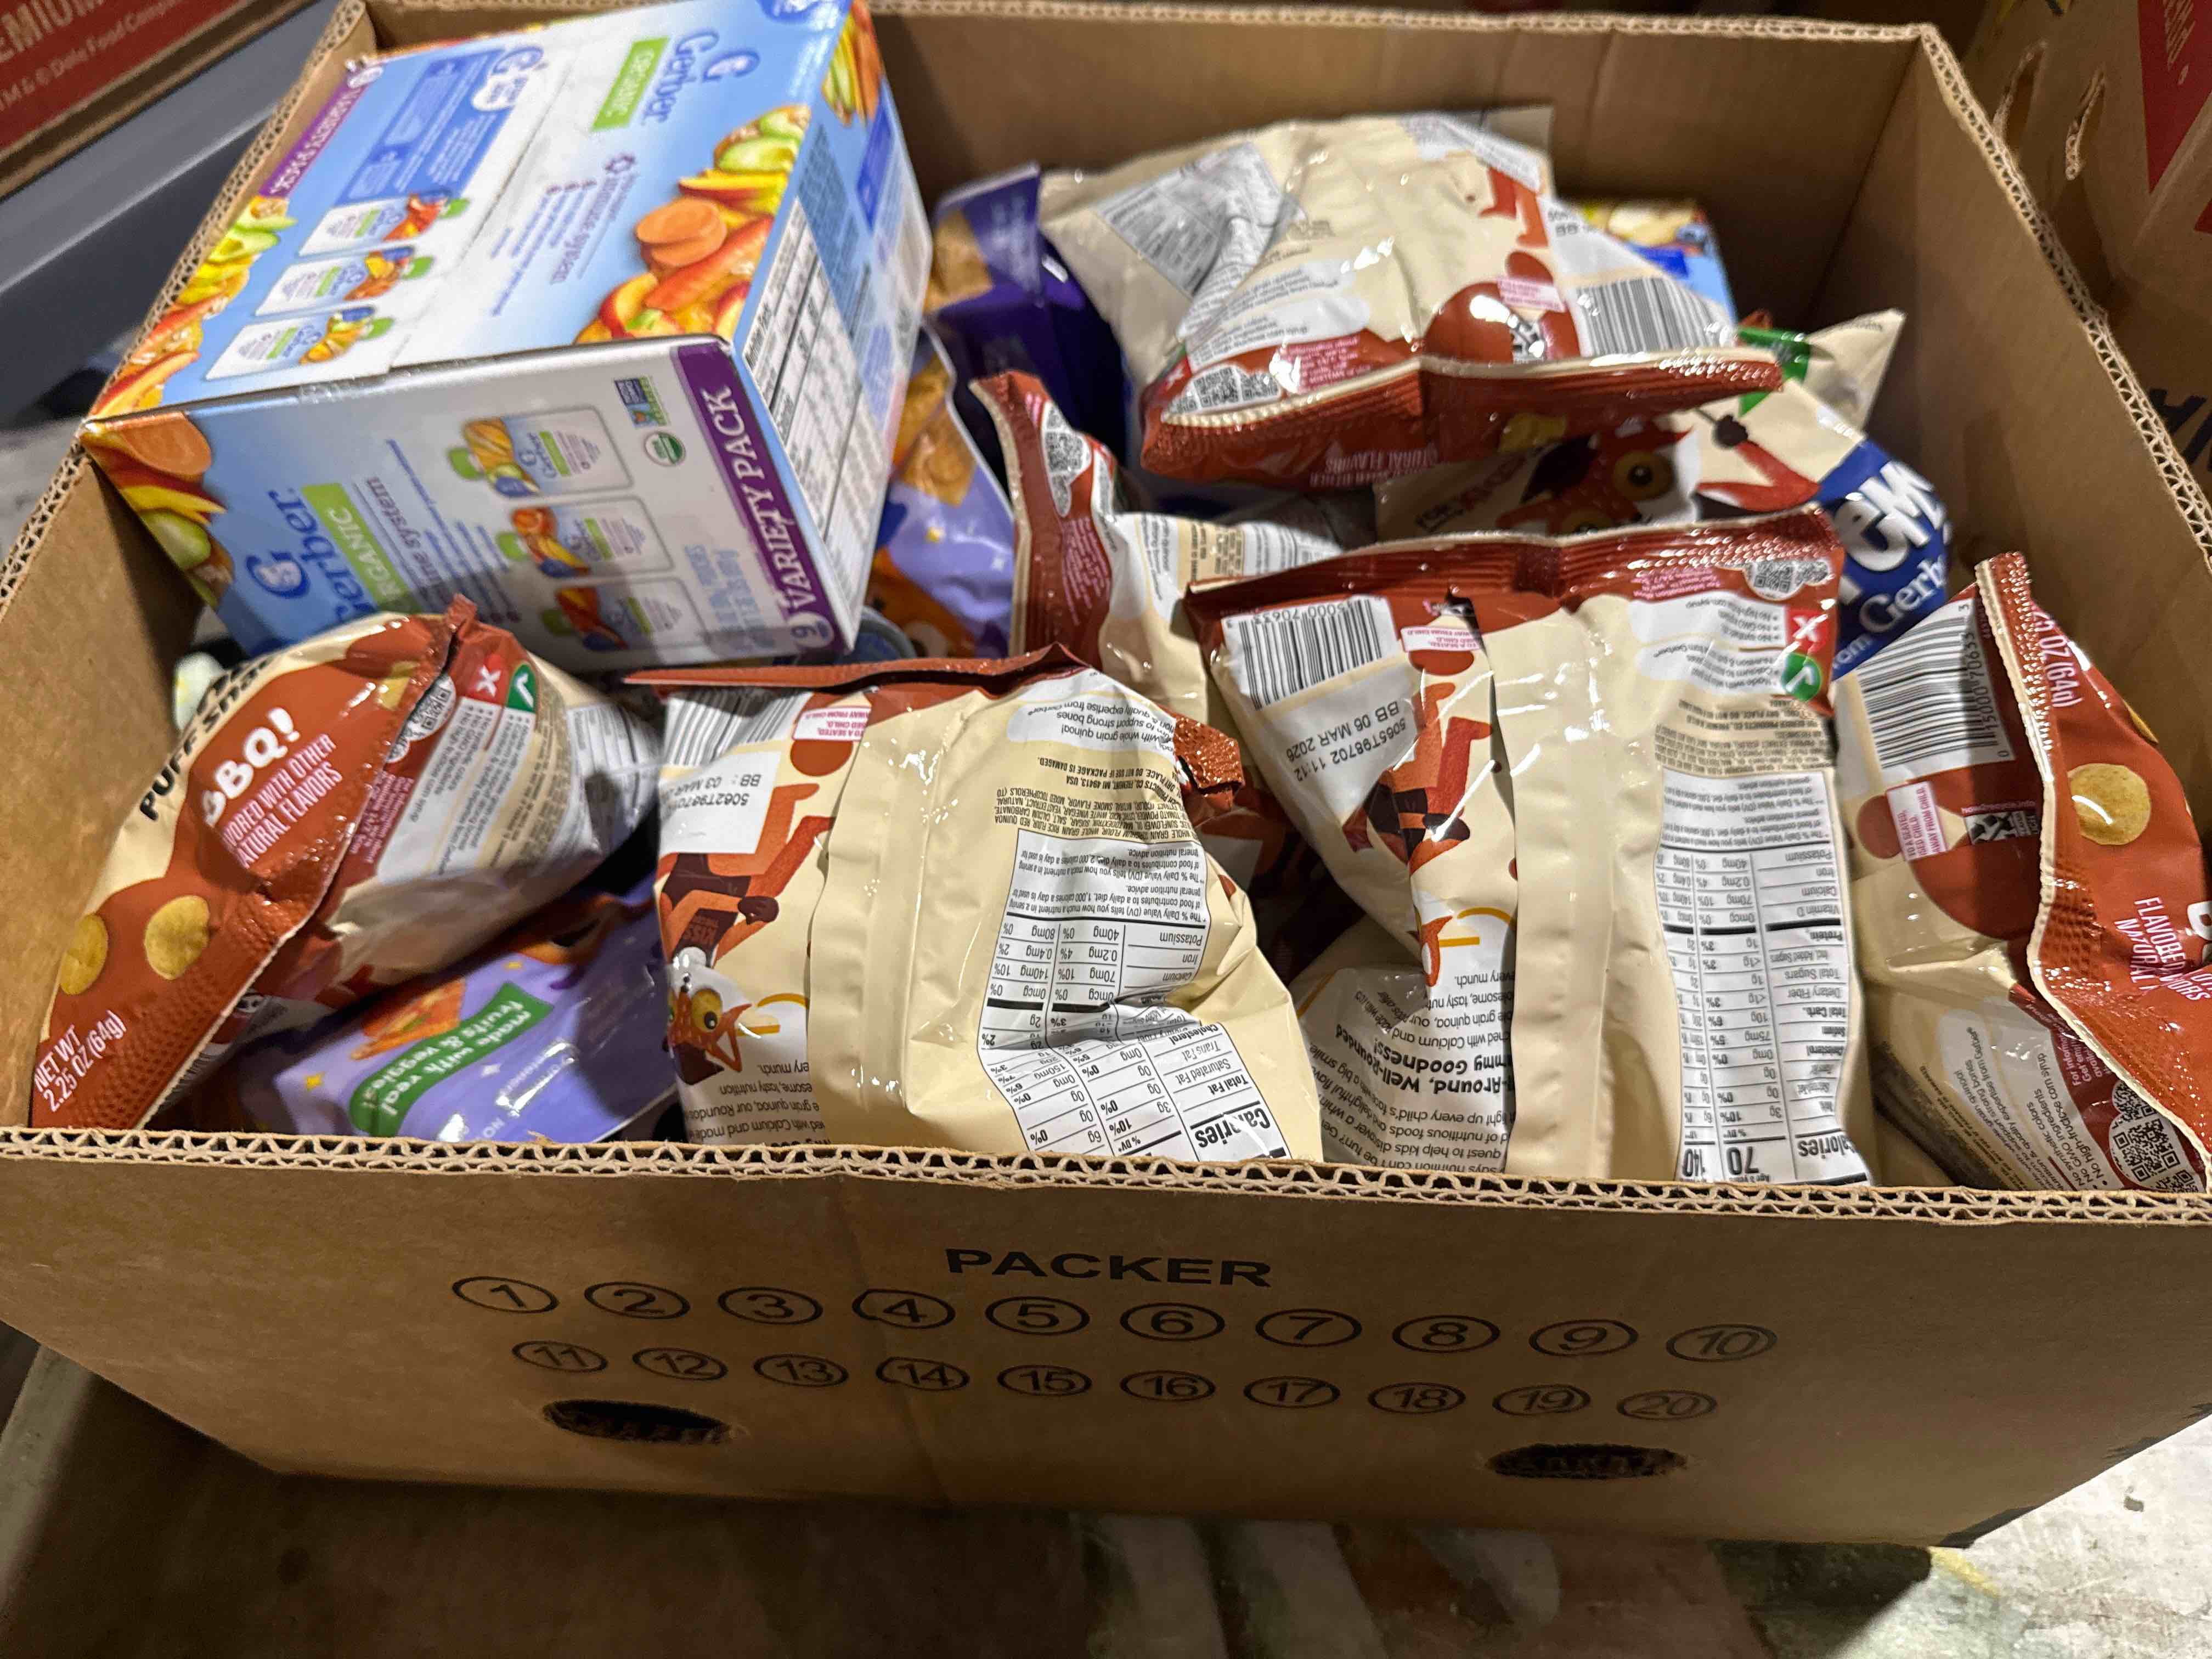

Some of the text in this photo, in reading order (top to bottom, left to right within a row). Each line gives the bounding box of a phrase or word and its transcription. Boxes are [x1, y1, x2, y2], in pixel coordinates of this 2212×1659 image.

[702, 386, 765, 481] PACK
[329, 507, 402, 603] RGANIC
[738, 484, 816, 609] VARIETY
[1086, 702, 1124, 716] expertise
[1057, 712, 1115, 729] strong bones
[1061, 724, 1094, 740] quinoa!
[1096, 728, 1119, 741] grain
[1119, 731, 1139, 743] whole
[1286, 700, 1399, 763] BB 06 MAR 2026
[1293, 718, 1407, 782] 5065T98702 11:12
[1077, 766, 1108, 778] PACKAGE
[221, 733, 337, 849] VORED WITH OTHER
[234, 760, 343, 870] ATURAL FLAVORS
[1093, 801, 1113, 810] SMOKE
[995, 815, 1017, 825] QUINOA
[1150, 830, 1169, 839] GRAIN
[1125, 885, 1149, 894] advice.
[1038, 892, 1194, 909] food contributes to daily diet. day
[1082, 905, 1095, 914] how
[1039, 906, 1062, 915] nutrient
[1111, 906, 1124, 915] tells
[1126, 907, 1141, 917] (DV)
[1144, 909, 1162, 918] Value
[1163, 909, 1180, 920] Daily
[1189, 912, 1201, 922] The
[1003, 923, 1203, 946] Potassium 40mg 0% 80mg 0%
[999, 943, 1198, 965] Iron 0.2mg 4% 0.4mg 2%
[994, 963, 1192, 983] Calcium 70mg 10% 140mg 10%
[1454, 974, 1488, 987] munch.
[1447, 995, 1468, 1009] tasty
[1030, 1014, 1067, 1028] 3% 2g
[1434, 1009, 1496, 1029] grain quinoa,
[1391, 1028, 1486, 1049] with Calcium and
[1744, 1029, 1771, 1043] 75mg
[33, 1024, 81, 1092] NET WT
[43, 1009, 127, 1112] 2.25 OZ (64g)
[1053, 1024, 1219, 1088] Cholesterol 0mg 0mg
[1373, 1039, 1468, 1075] Goodness!
[2036, 1052, 2051, 1079] syrup
[757, 1064, 791, 1075] munch.
[1071, 1039, 1221, 1103] Trans Fat 0g 0g
[1101, 1058, 1231, 1115] Saturated Fat 0g 0%
[1109, 1073, 1249, 1135] Total Fat 3g 10%
[1389, 1107, 1483, 1126] up every child's
[727, 1119, 791, 1137] Calcium and
[1194, 1108, 1271, 1148] Caries
[1389, 1125, 1483, 1142] nutritious foods
[1394, 1144, 1502, 1160] quest to help kids
[1726, 1146, 1759, 1177] 70
[2061, 1141, 2082, 1168] GMO
[945, 1248, 1272, 1288] PACKER
[490, 1284, 1752, 1357] 1 2 3 4 5 6 7 8 9 10
[533, 1346, 1699, 1417] 11 12 13 14 15 16 17 18 19 20
